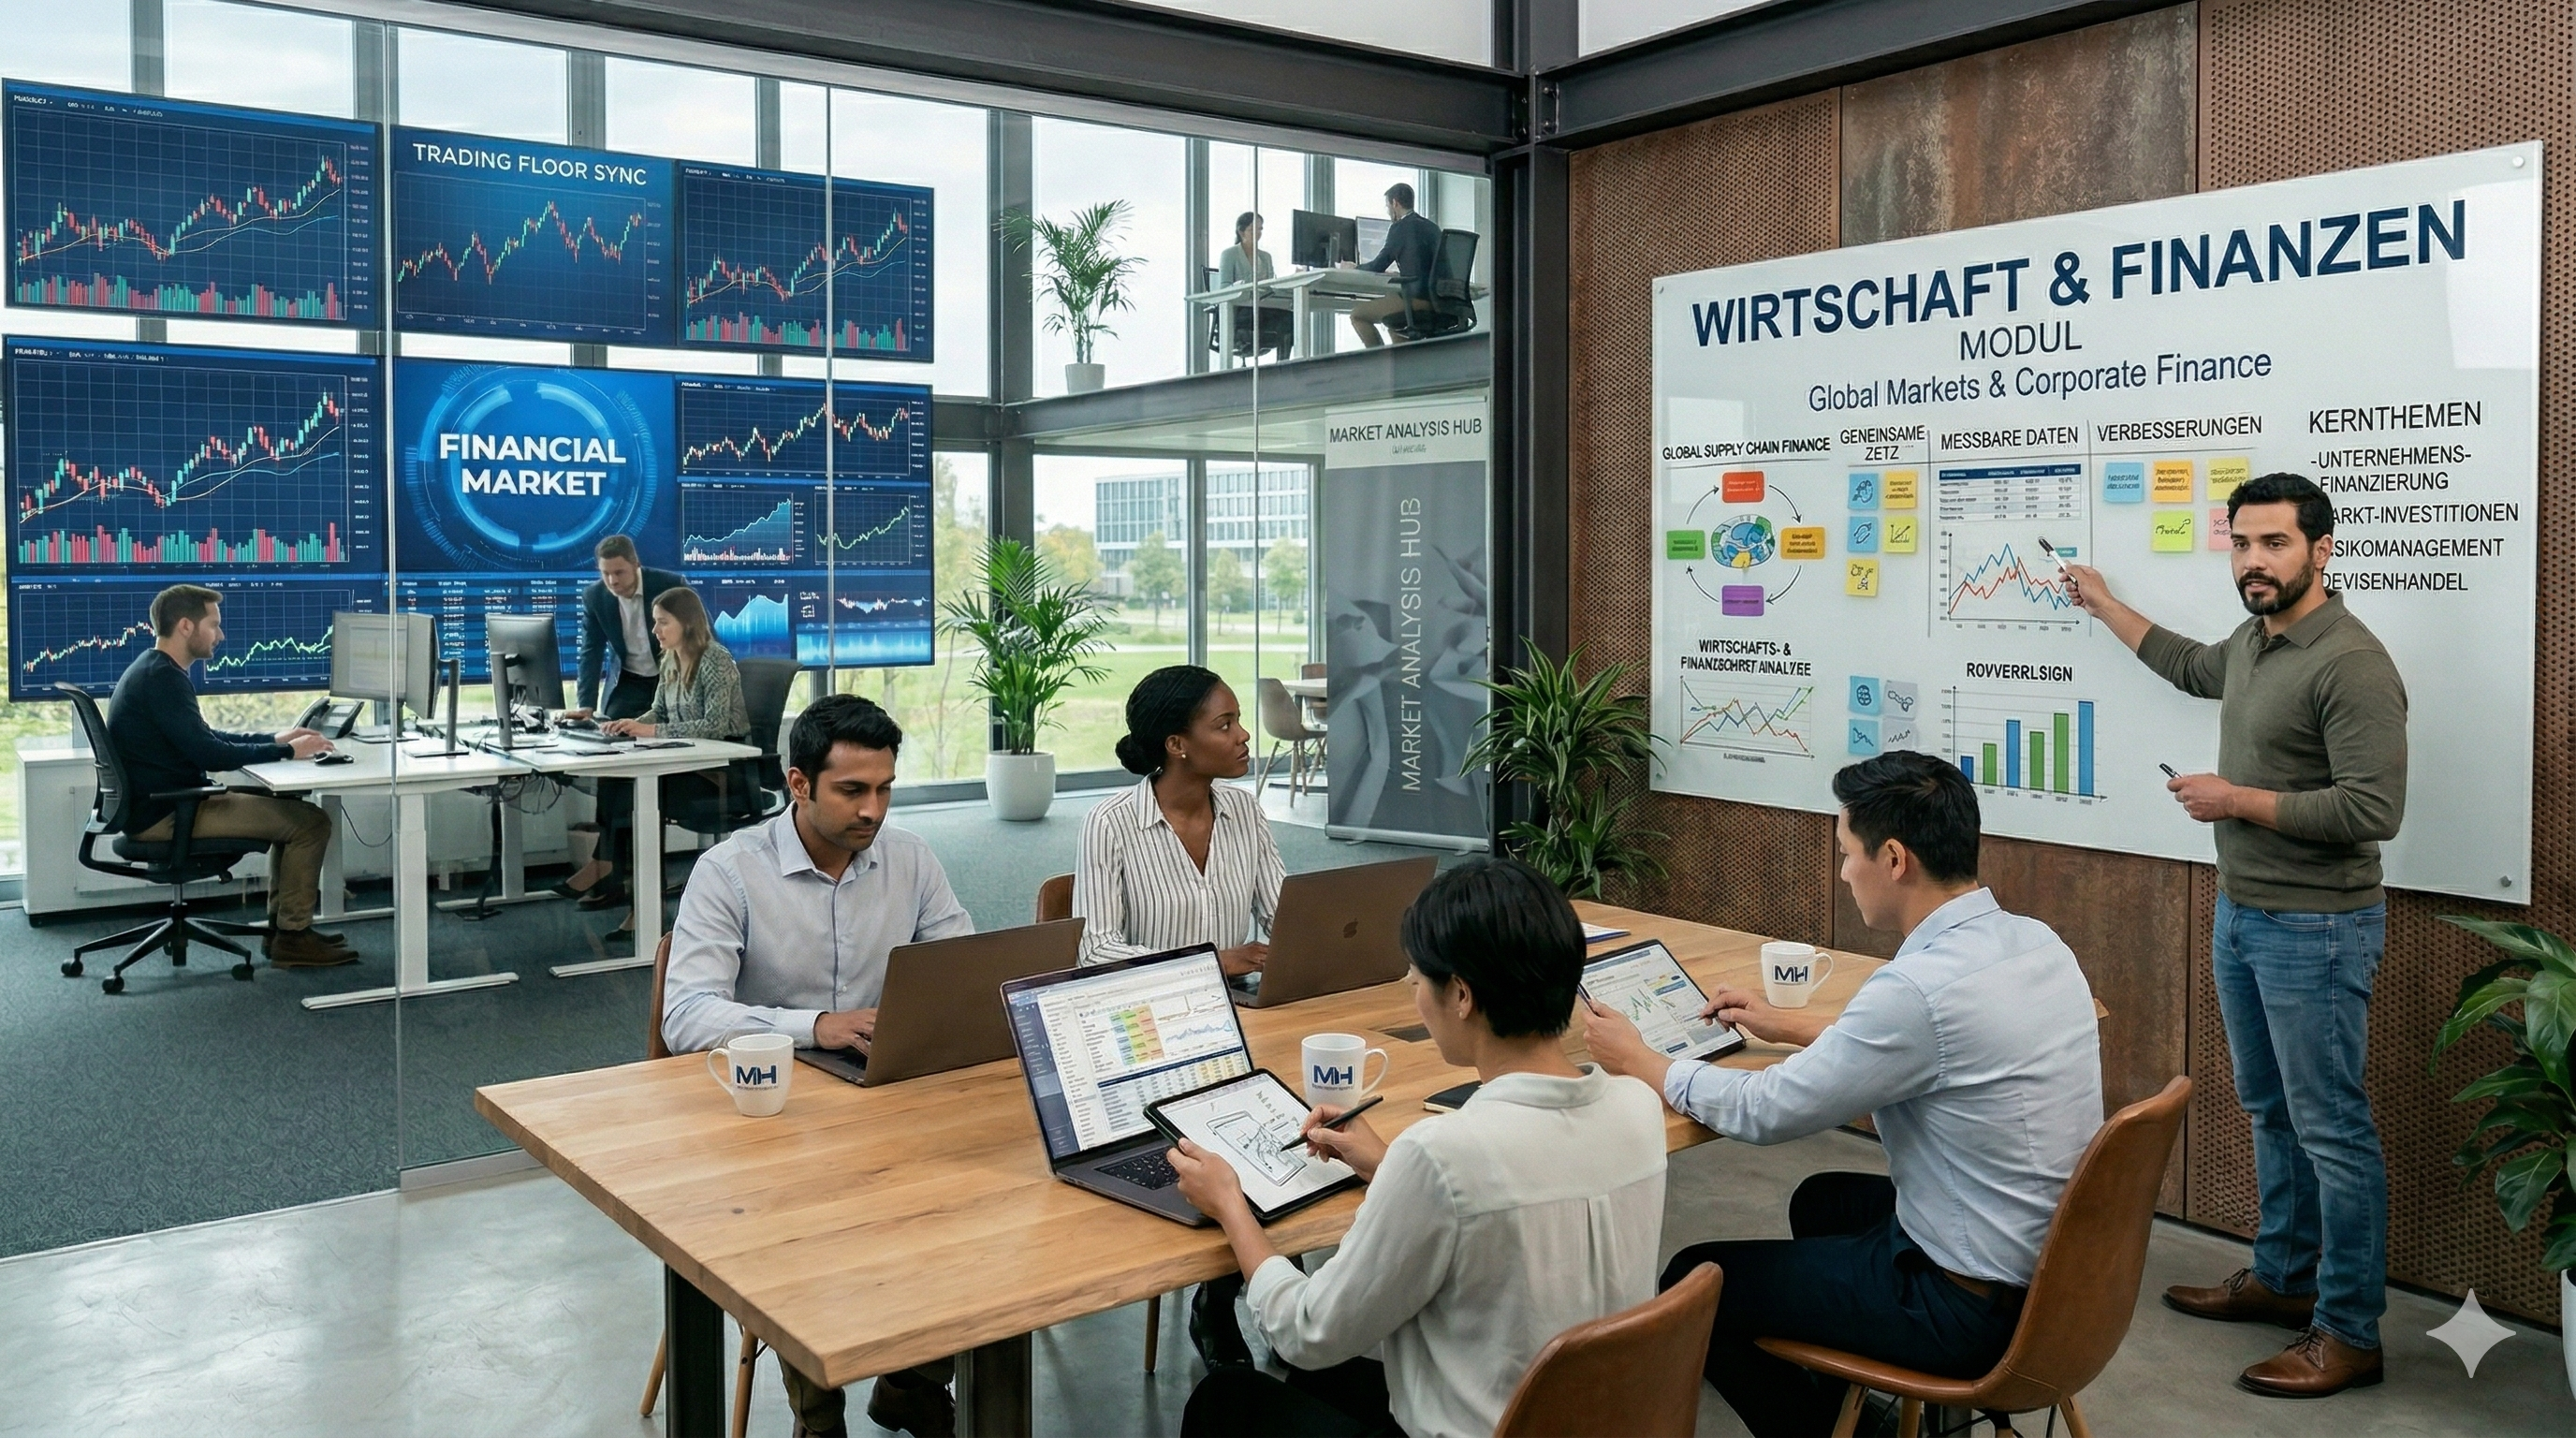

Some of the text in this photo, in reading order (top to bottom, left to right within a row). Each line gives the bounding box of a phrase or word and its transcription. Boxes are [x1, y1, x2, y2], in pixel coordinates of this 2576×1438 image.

[413, 143, 647, 186] TRADING FLOOR SYNC
[1691, 199, 2466, 346] WIRTSCHAFT & FINANZEN
[1960, 320, 2083, 361] MODUL
[1808, 353, 2273, 412] Global Markets & Corporate Finance
[2309, 401, 2481, 433] KERNTHEMEN
[1330, 418, 1482, 443] MARKET ANALYSIS HUB
[1840, 425, 1925, 444] GENEINSAME
[1941, 426, 2078, 450] MESSBARE DATEN
[2098, 416, 2262, 442] VERBESSERUNGEN
[440, 433, 626, 464] FINANCIAL
[1662, 437, 1831, 460] GLOBAL SUPPLY CHAIN FINANCE
[1865, 446, 1899, 461] ZETZ
[2311, 445, 2471, 468] -UNTERNEHMENS-
[461, 468, 607, 496] MARKET
[2320, 472, 2449, 493] FINANZIERUNG
[2333, 503, 2518, 524] ARKT-INVESTITIONEN
[2330, 538, 2504, 557] SIKOMANAGEMENT
[2322, 573, 2468, 591] DEVISENHANDEL
[1400, 498, 1421, 790] MARKET ANALYSIS HUB
[1699, 639, 1792, 656] WIRTSCHAFTS- &
[1775, 965, 1808, 982] MH
[737, 1065, 776, 1085] MH
[1313, 1065, 1353, 1085] MH
